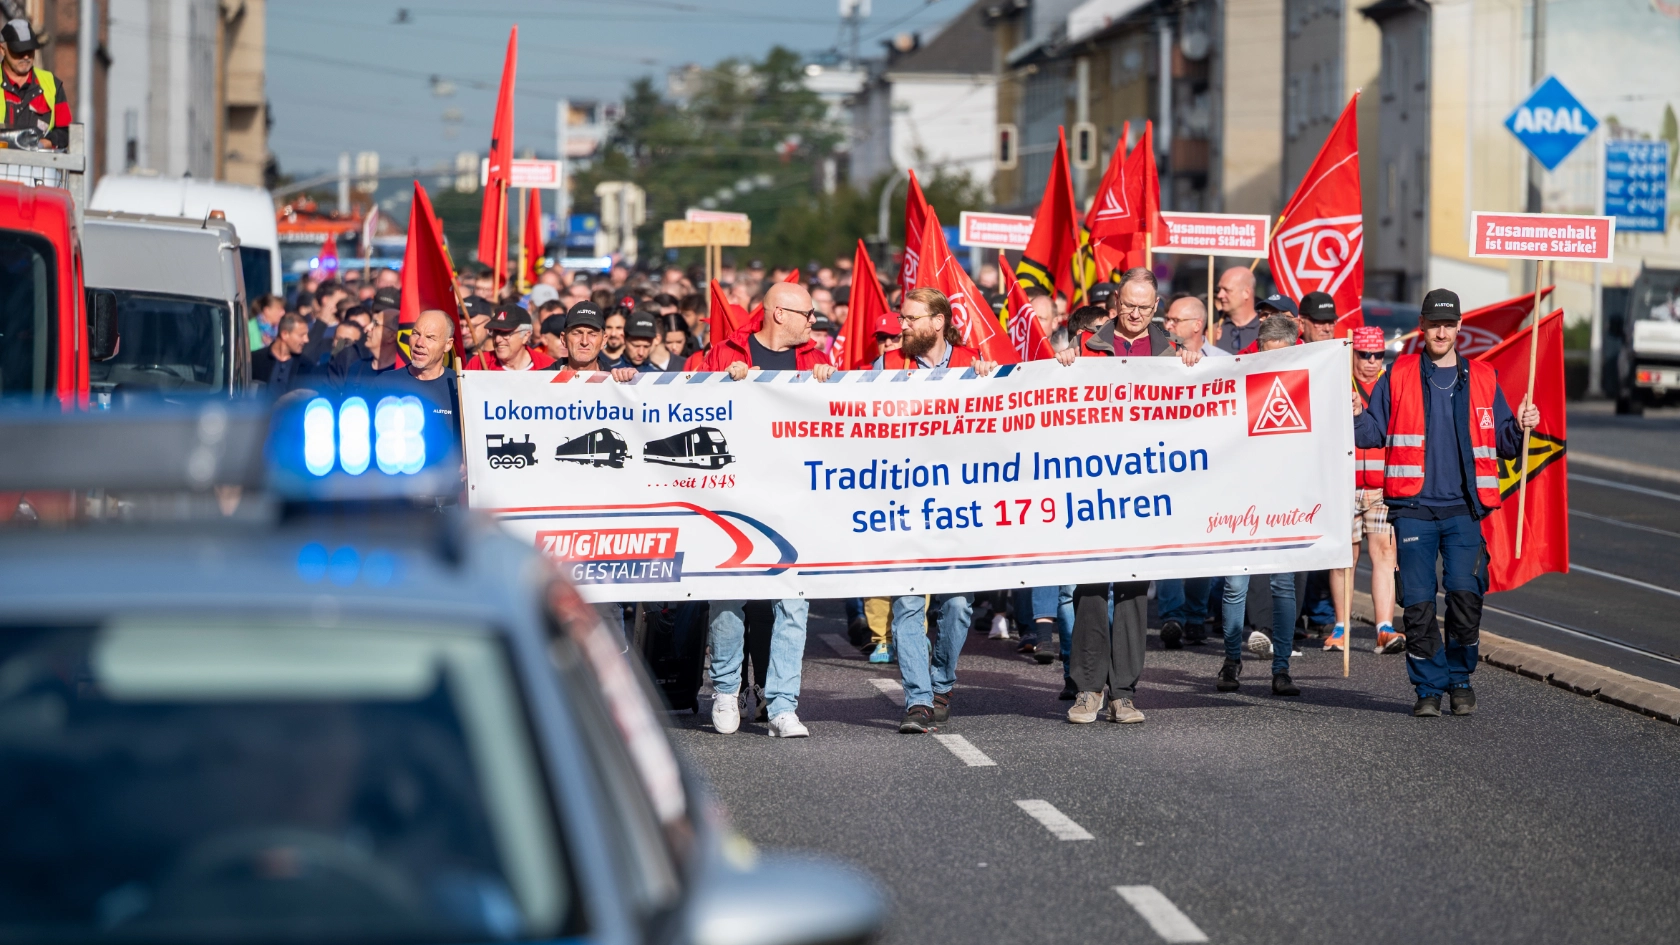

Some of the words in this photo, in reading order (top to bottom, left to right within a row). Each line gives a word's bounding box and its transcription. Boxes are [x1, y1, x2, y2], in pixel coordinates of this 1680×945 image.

[1513, 106, 1589, 134] ARAL
[1181, 236, 1216, 246] unsere
[1218, 235, 1256, 247] Stärke!
[1486, 222, 1597, 240] Zusammenhalt
[1485, 237, 1502, 250] ist
[1504, 240, 1548, 252] unsere
[1550, 240, 1597, 253] Stärke!
[829, 401, 867, 417] WIR
[872, 398, 960, 417] FORDERN
[965, 395, 1004, 413] EINE
[1008, 386, 1079, 410] SICHERE
[1084, 382, 1197, 403] ZU[G]KUNFT
[1201, 378, 1236, 398] FÜR
[484, 399, 634, 421] Lokomotivbau
[642, 402, 660, 423] in
[668, 400, 733, 423] Kassel
[772, 421, 845, 438] UNSERE
[850, 415, 997, 439] ARBEITSPLÄTZE
[1002, 412, 1036, 433] UND
[1040, 406, 1124, 428] UNSEREN
[1129, 399, 1237, 422] STANDORT!
[804, 458, 950, 491] Tradition
[962, 452, 1021, 485] und
[1033, 441, 1208, 481] Innovation
[672, 476, 697, 489] seit
[701, 474, 735, 490] 1848
[852, 500, 912, 533] seit
[921, 497, 983, 530] fast
[1065, 488, 1172, 529] Jahren
[1206, 504, 1260, 536] simply
[1265, 503, 1321, 528] united
[572, 561, 674, 581] GESTALTEN
